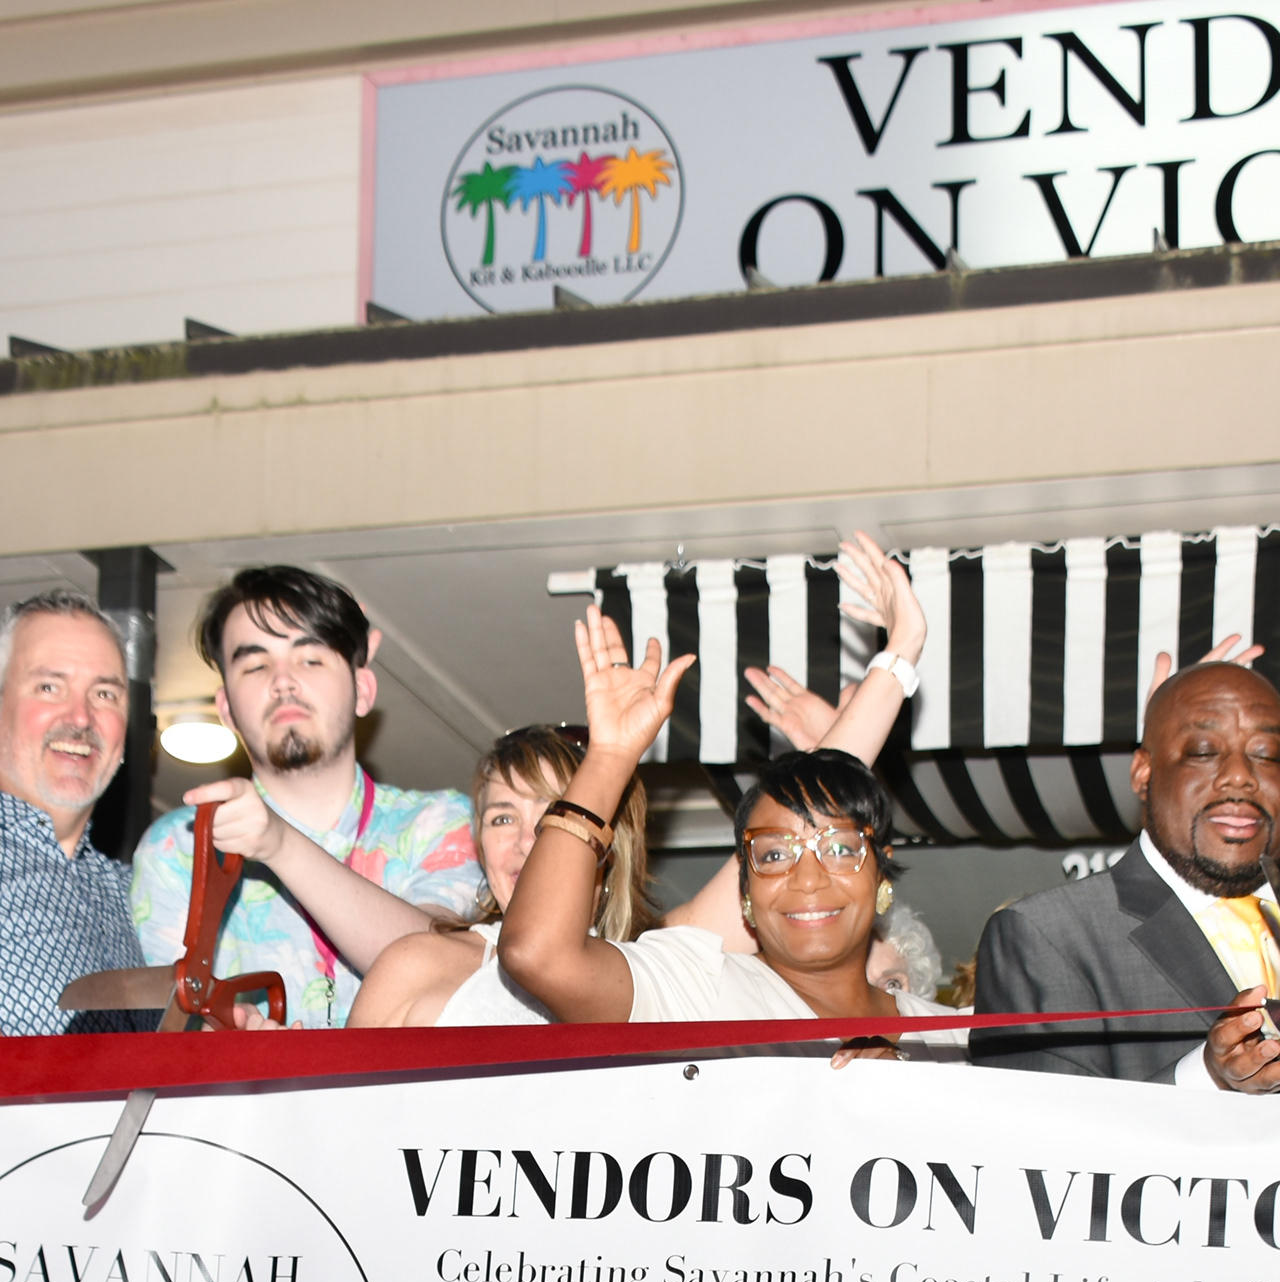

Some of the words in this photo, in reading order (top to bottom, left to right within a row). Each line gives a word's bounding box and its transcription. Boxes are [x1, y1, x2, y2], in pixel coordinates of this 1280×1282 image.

[485, 110, 640, 155] Savannah
[738, 180, 976, 290] ON
[470, 266, 496, 288] Kit
[500, 267, 516, 284] &
[521, 255, 608, 283] Kaboodle
[613, 254, 653, 275] LLC
[1061, 850, 1127, 880] 21
[398, 1147, 813, 1225] VENDORS
[850, 1157, 984, 1235] ON
